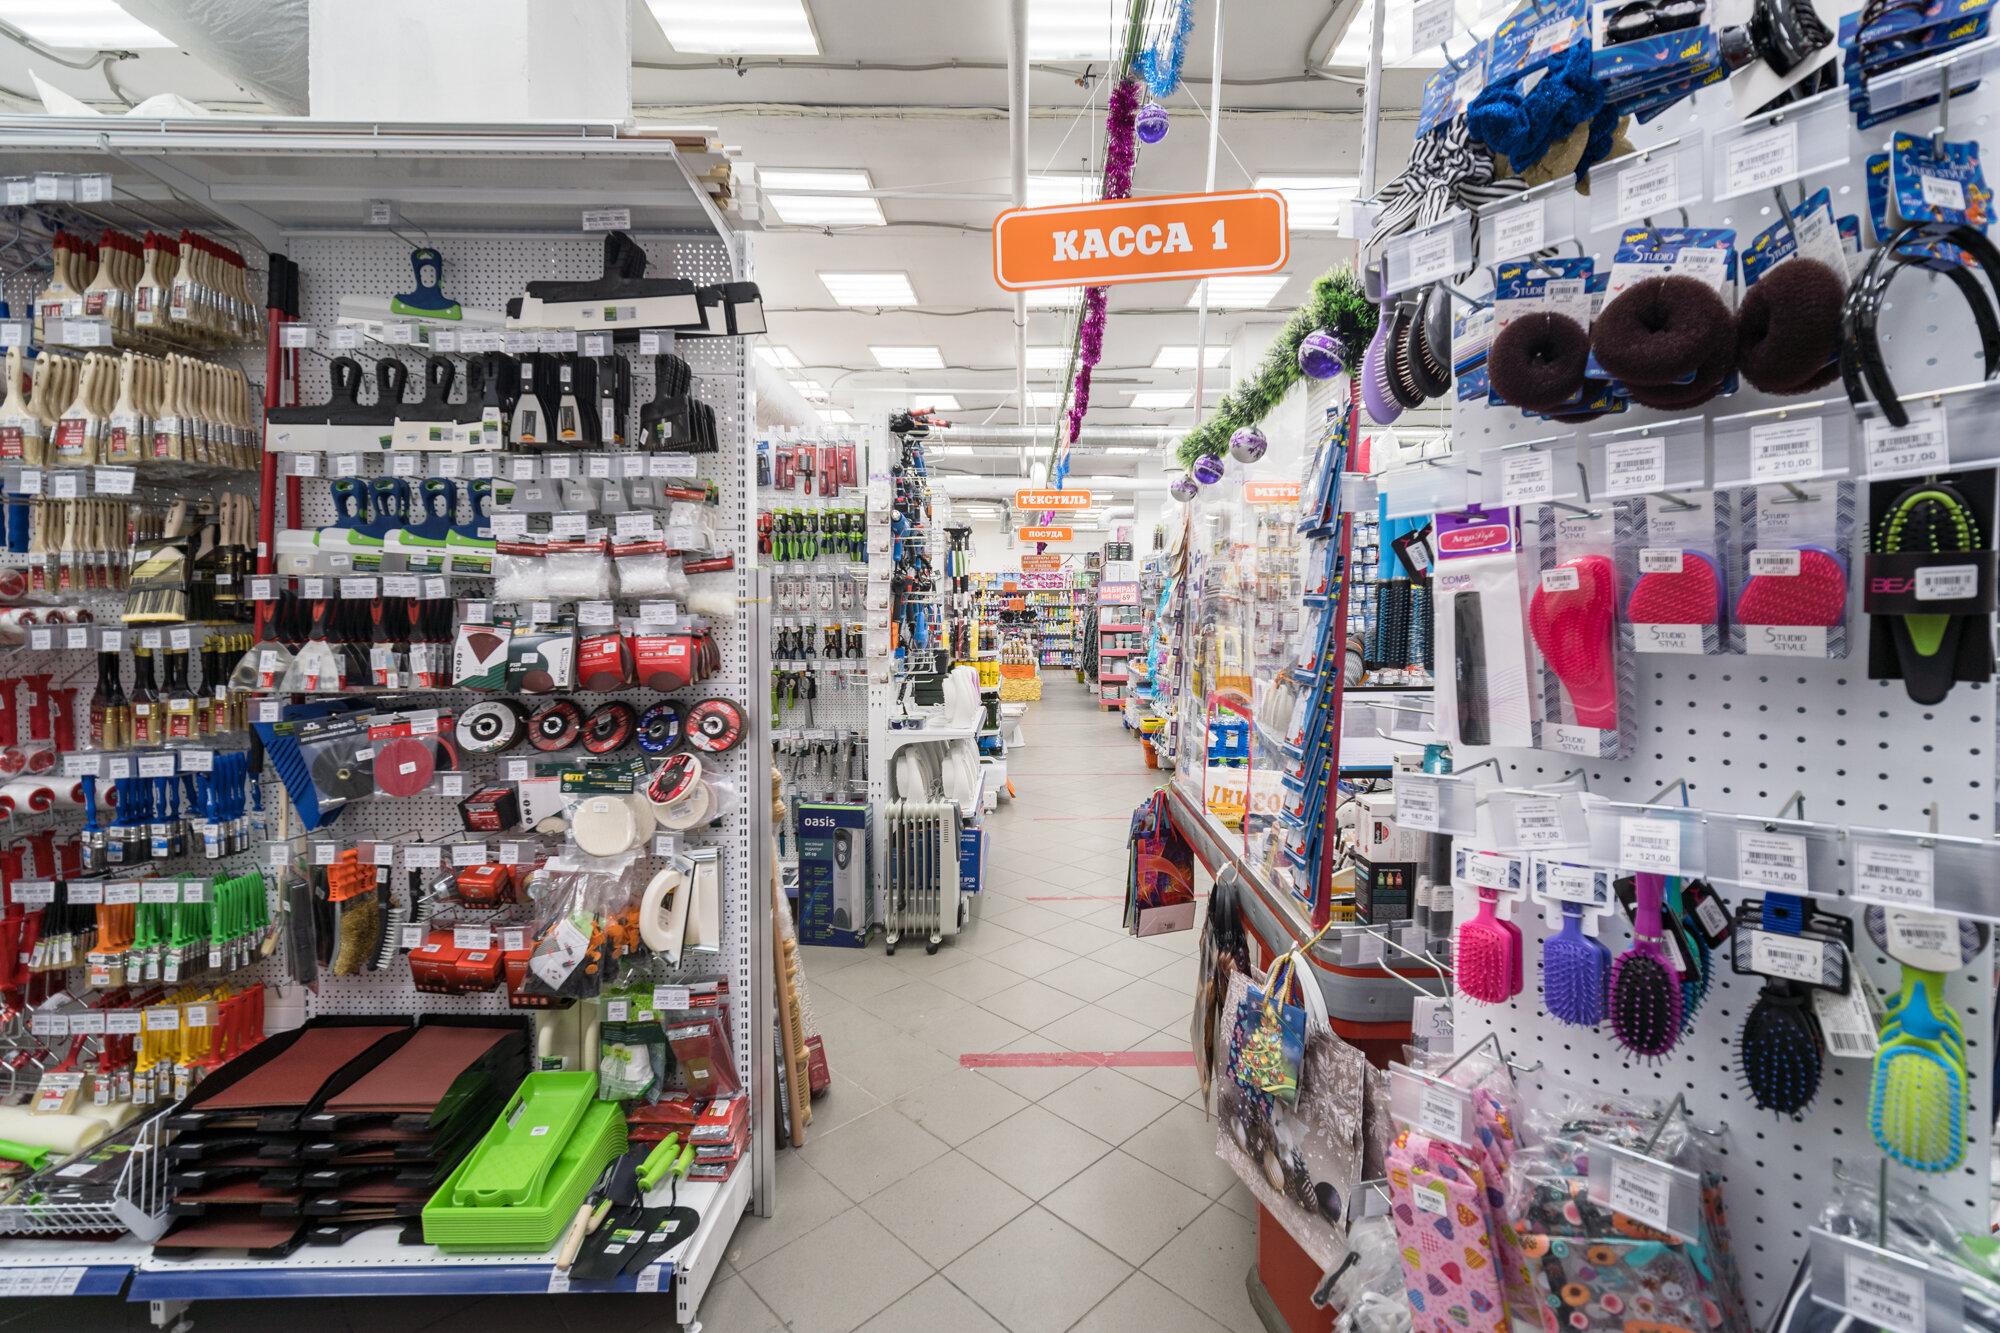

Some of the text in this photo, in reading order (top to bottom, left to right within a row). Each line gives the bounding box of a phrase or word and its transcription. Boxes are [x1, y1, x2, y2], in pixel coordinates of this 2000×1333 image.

[1871, 161, 1890, 175] WOW
[1052, 219, 1228, 262] КАССА 1
[1626, 232, 1649, 244] WOW!
[1633, 244, 1675, 263] STUDIO
[1501, 267, 1521, 280] WOW!
[1892, 451, 1938, 465] 137,00
[1773, 458, 1813, 471] 210,00
[1624, 474, 1657, 485] 210,00
[1254, 487, 1301, 497] МЕТИ
[1021, 495, 1087, 504] ТЕКСТИЛЬ
[1761, 510, 1790, 522] STUDIO
[1559, 520, 1586, 535] STUDIO
[1650, 518, 1676, 529] STUDIO
[1028, 530, 1064, 538] ПОСУДА
[1441, 574, 1471, 585] COMB
[1871, 577, 1916, 593] BEA
[1100, 584, 1137, 593] НАБИРАЙ
[1649, 625, 1687, 641] STUDIO
[1763, 628, 1808, 644] STUDIO
[1658, 639, 1687, 648] STYLE
[1774, 642, 1806, 652] STYLE
[1556, 728, 1586, 744] STUDIO
[1561, 743, 1586, 752] STYLE
[804, 816, 836, 827] oasis
[1639, 852, 1671, 863] 121,00
[1761, 870, 1797, 882] 111,00
[1879, 884, 1923, 898] 210,00
